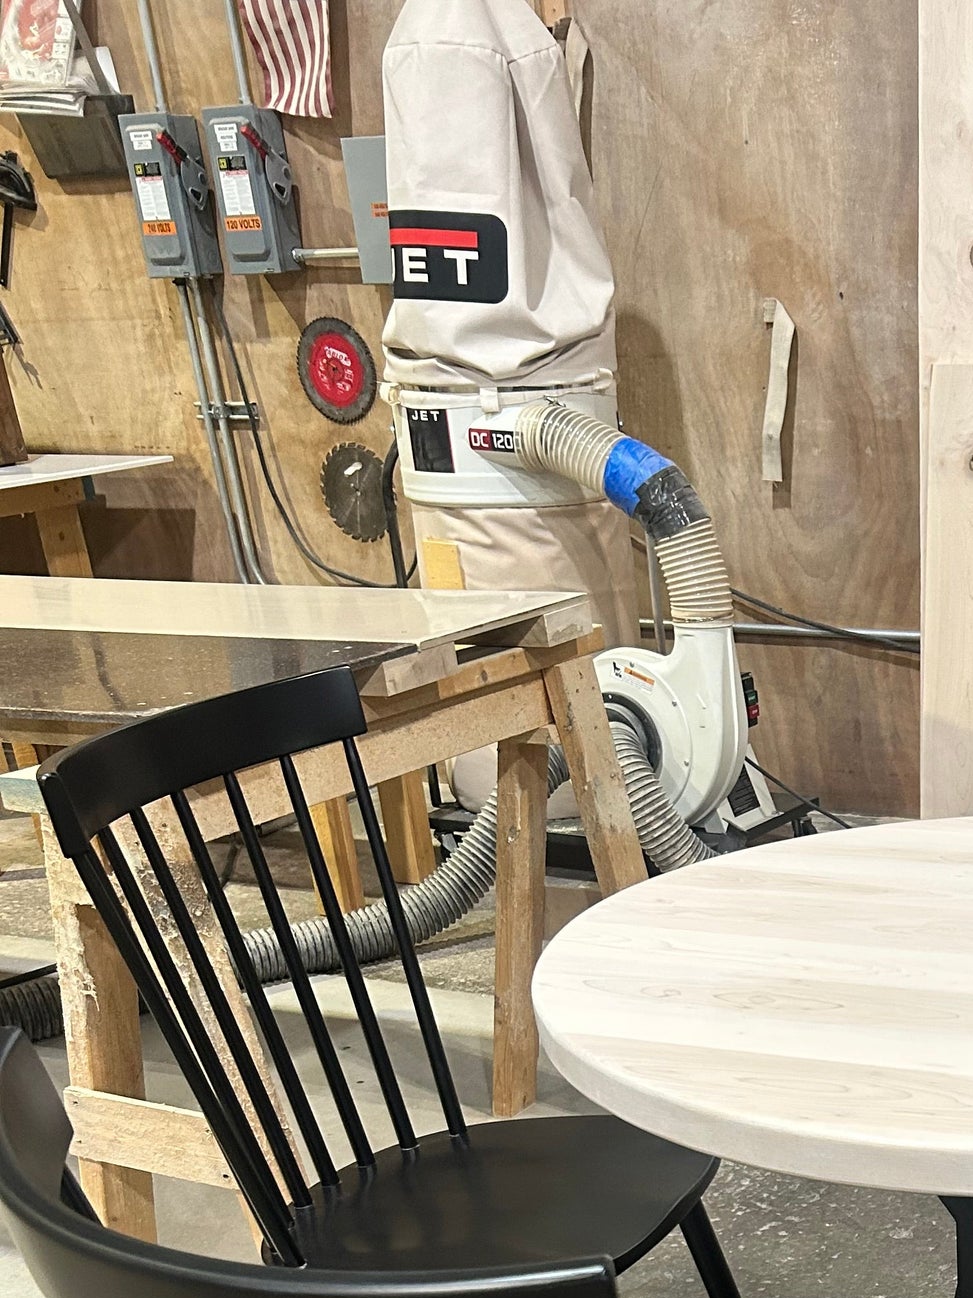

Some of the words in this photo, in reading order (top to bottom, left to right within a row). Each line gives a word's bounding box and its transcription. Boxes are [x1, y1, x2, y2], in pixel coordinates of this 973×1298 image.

[157, 222, 171, 233] VOLTS
[226, 220, 238, 230] 120
[238, 218, 261, 229] VOLTS
[391, 247, 479, 286] ET
[411, 410, 440, 422] JET
[470, 431, 489, 448] DC
